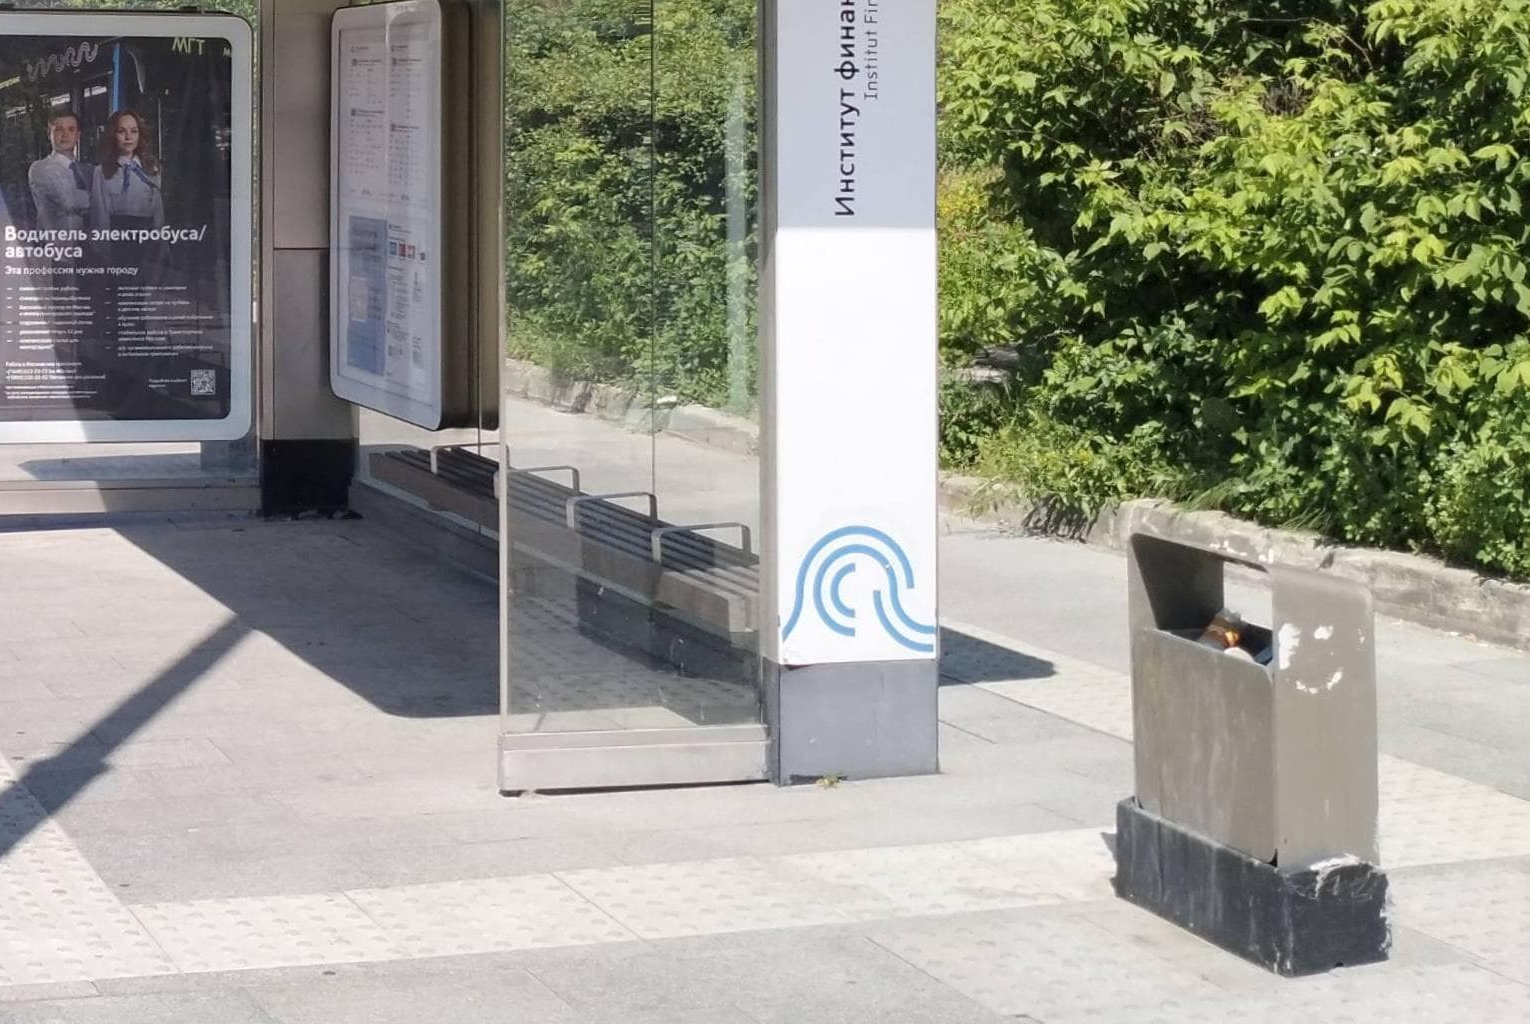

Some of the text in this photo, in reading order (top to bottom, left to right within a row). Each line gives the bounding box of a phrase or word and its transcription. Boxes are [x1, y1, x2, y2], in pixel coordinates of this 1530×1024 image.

[863, 29, 879, 101] Institut
[834, 87, 861, 217] Институт
[4, 224, 207, 245] Водитель электробуса/
[5, 243, 84, 261] автобуса
[4, 265, 139, 277] Эта профессия нужна городу
